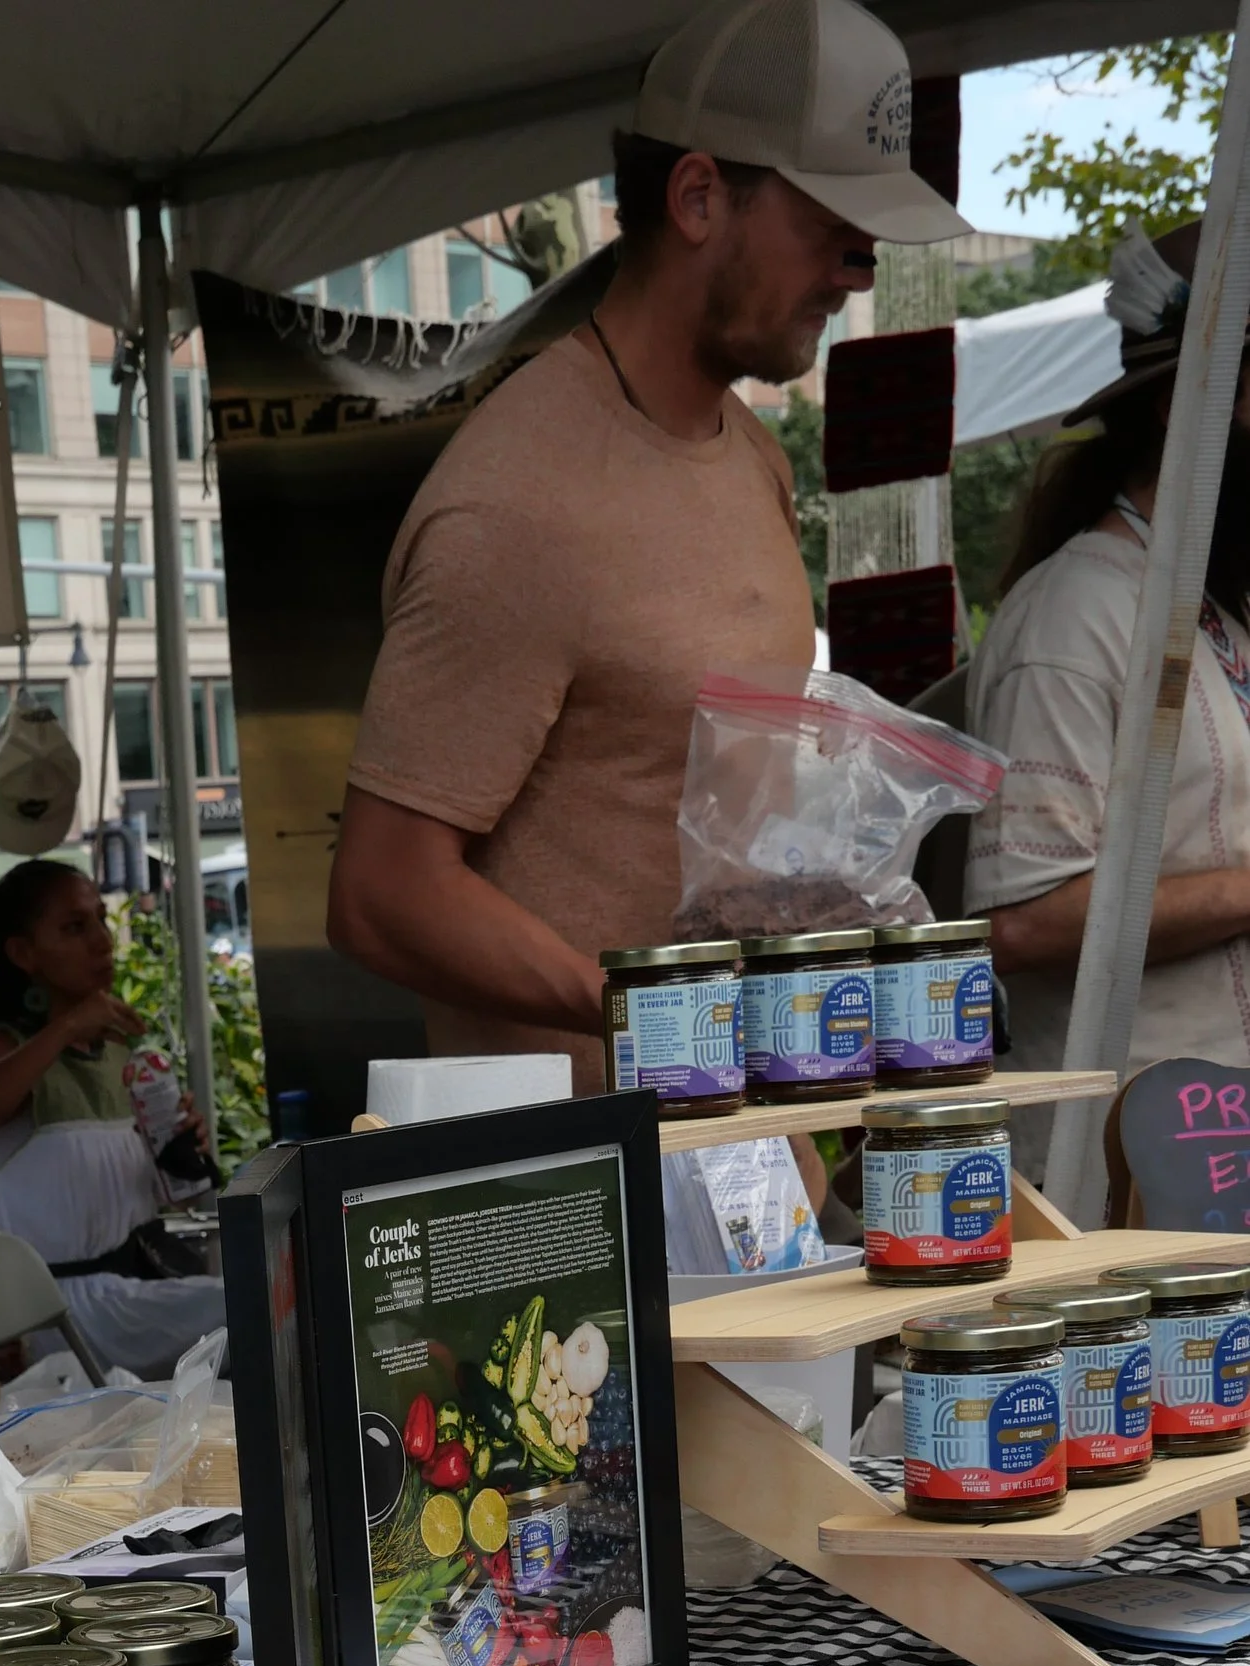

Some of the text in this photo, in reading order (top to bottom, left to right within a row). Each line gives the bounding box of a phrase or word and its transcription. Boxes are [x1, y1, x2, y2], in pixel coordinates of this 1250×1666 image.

[834, 980, 868, 996] JAMAICAN
[638, 992, 662, 1000] AUTHENTIC
[646, 1000, 669, 1008] EVERY
[670, 998, 684, 1006] JAR
[840, 992, 864, 1006] JERK
[832, 1008, 869, 1016] MARINADE
[958, 1158, 998, 1176] JAMAICAN
[966, 1170, 994, 1186] JERK
[344, 1192, 364, 1204] east
[955, 1186, 1000, 1196] MARINADE
[970, 1200, 991, 1209] Original
[370, 1218, 420, 1244] Couple
[364, 1242, 422, 1268] of Jerks
[390, 1269, 401, 1280] pair
[402, 1267, 410, 1277] of
[410, 1266, 422, 1275] new
[392, 1276, 424, 1289] marinades
[374, 1286, 424, 1303] mixes Maine and
[374, 1297, 424, 1314] Jamaican flavors.
[1134, 1364, 1150, 1381] JERK
[1006, 1384, 1052, 1402] JAMAICAN
[1014, 1397, 1045, 1414] JERK
[1003, 1412, 1052, 1424] MARINADE
[1019, 1429, 1042, 1439] Original
[1000, 1482, 1012, 1491] NET
[1012, 1480, 1022, 1490] WT.
